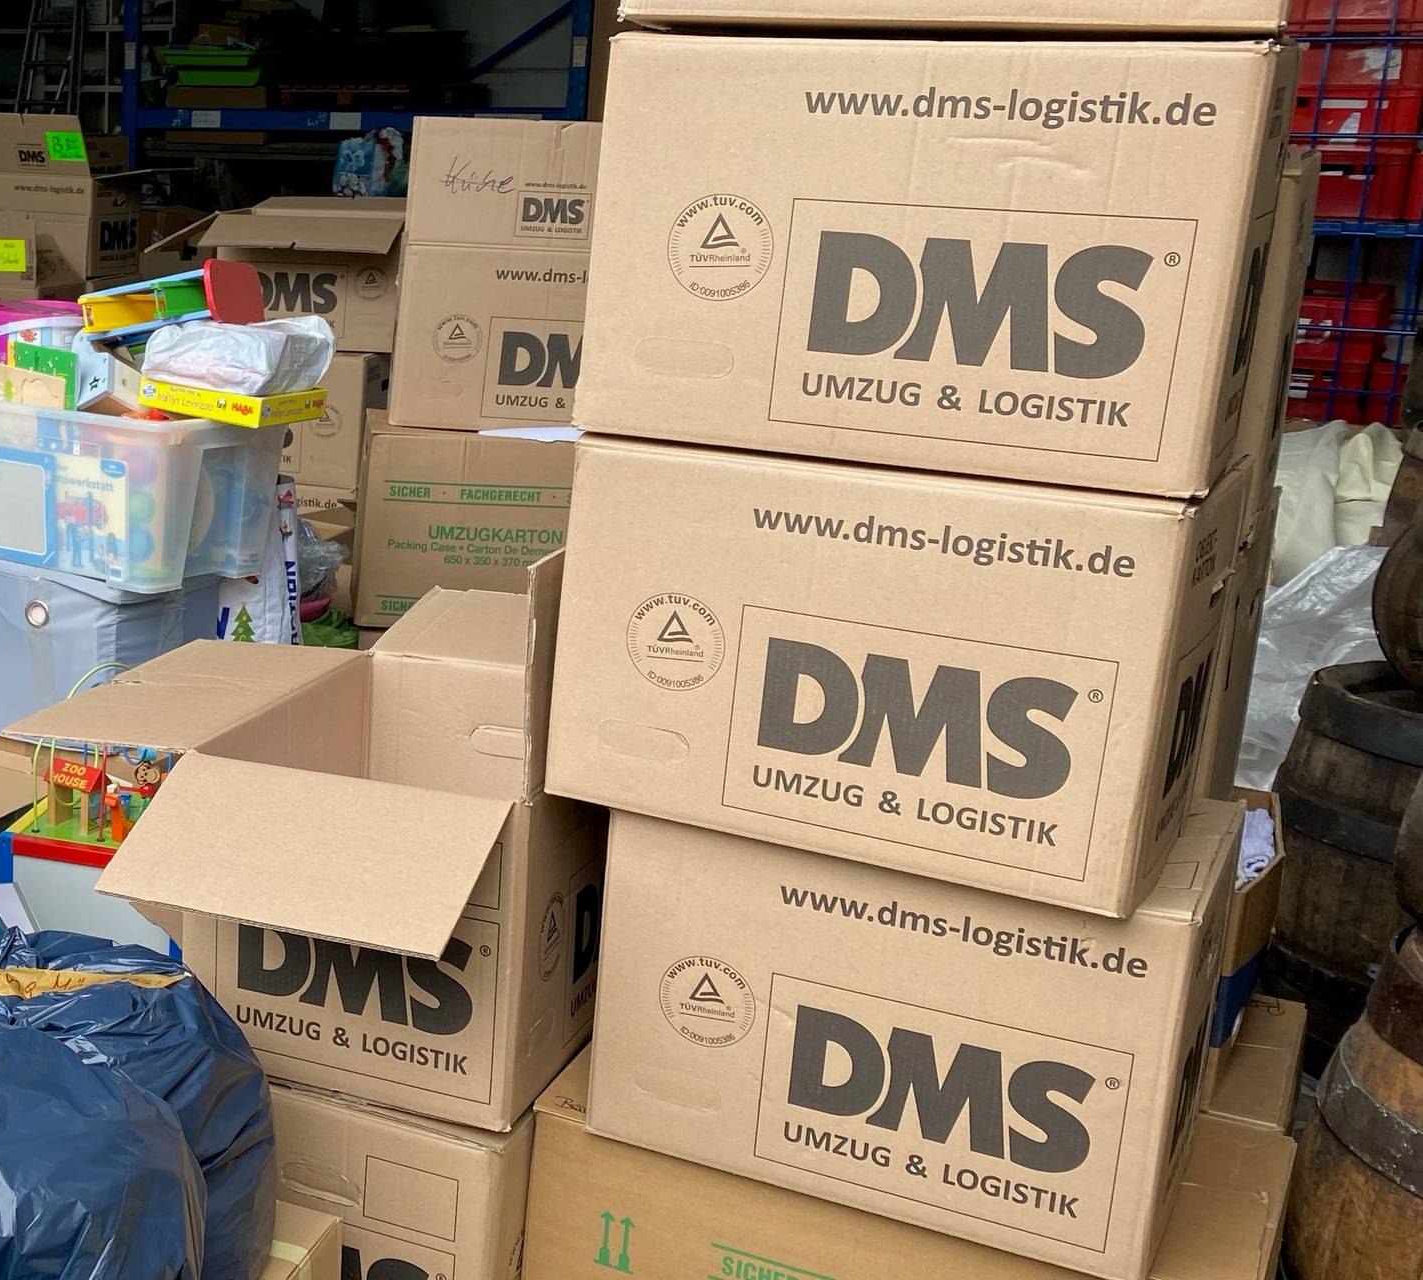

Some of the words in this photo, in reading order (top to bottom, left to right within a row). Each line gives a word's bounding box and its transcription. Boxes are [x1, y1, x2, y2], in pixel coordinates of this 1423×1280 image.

[806, 87, 1217, 129] www.dms-logistik.de
[19, 150, 45, 163] DMS
[14, 184, 85, 195] www.dms-logistik.de
[522, 197, 586, 224] DMS
[677, 196, 764, 228] www.tuv.com
[99, 214, 137, 251] DMS
[520, 225, 545, 233] UMZUG
[689, 253, 751, 262] TÜVRheinland
[496, 268, 589, 284] www.dms-l
[807, 230, 1154, 380] DMS
[498, 331, 583, 389] DM
[231, 403, 254, 415] HABA
[496, 394, 548, 408] UMZUG
[555, 397, 566, 408] &
[801, 372, 922, 406] UMZUG
[937, 385, 962, 411] &
[978, 389, 1131, 428] LOGISTIK
[390, 485, 431, 499] SICHER
[460, 488, 542, 503] FACHGERECHT
[387, 539, 427, 552] Packing
[430, 542, 456, 552] Case
[466, 544, 501, 554] Carton
[504, 545, 519, 555] De
[428, 525, 563, 544] UMZUGKARTON
[753, 507, 1136, 577] www.dms-logistik.de
[444, 555, 462, 564] 650
[464, 557, 471, 565] x
[472, 556, 491, 566] 350
[493, 558, 500, 566] x
[501, 557, 520, 567] 370
[635, 594, 716, 626] www.tuv.com
[647, 643, 704, 657] TÜVRheinland
[757, 636, 1079, 799] DMS
[61, 763, 86, 776] ZOO
[752, 764, 864, 807] UMZUG
[878, 790, 902, 816] &
[917, 798, 1059, 846] LOGISTIK
[780, 884, 1149, 978] www.dms-logistik.de
[238, 923, 473, 1036] DMS
[667, 957, 746, 990] www.tuv.com
[570, 977, 596, 1018] UMZU
[679, 1002, 735, 1019] TÜVRheinland
[235, 1004, 321, 1040] UMZUG
[332, 1026, 350, 1048] &
[362, 1033, 469, 1075] LOGISTIK
[787, 1004, 1097, 1173] DMS
[782, 1121, 891, 1168] UMZUG
[905, 1154, 928, 1179] &
[942, 1164, 1080, 1219] LOGISTIK
